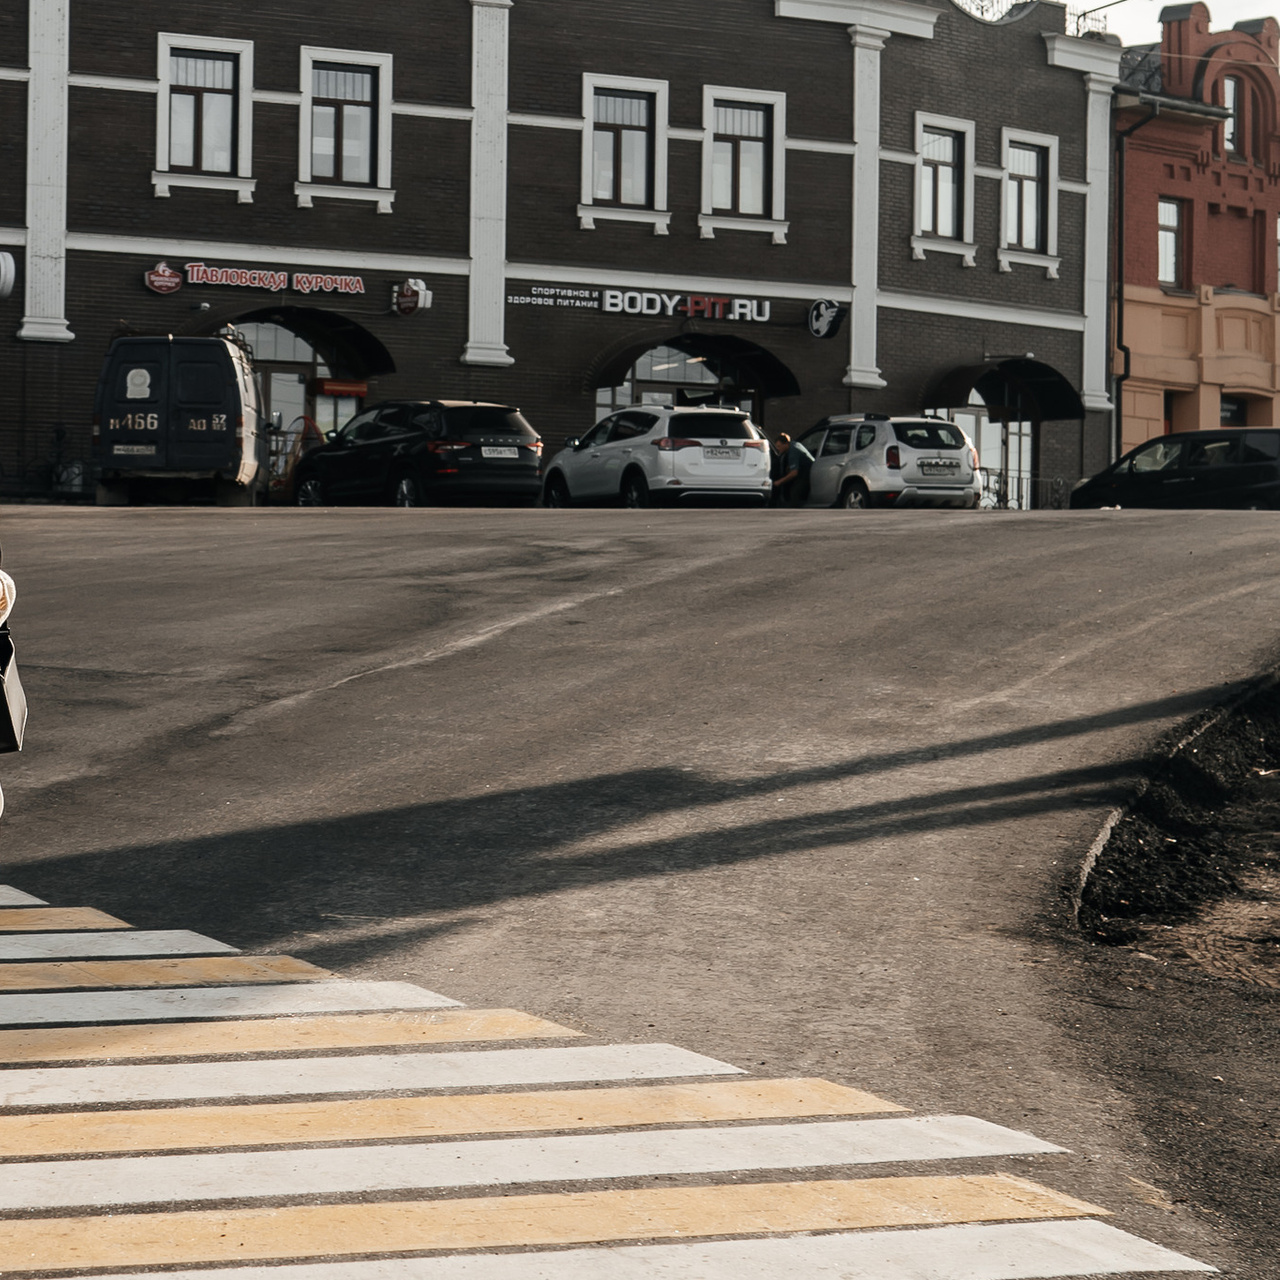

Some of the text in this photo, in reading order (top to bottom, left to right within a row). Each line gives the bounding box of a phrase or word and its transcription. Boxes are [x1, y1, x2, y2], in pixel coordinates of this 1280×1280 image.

[531, 287, 590, 298] СПОРТИВНОЕ
[507, 295, 599, 308] ЗДОРОВОЕ ПИТАНИЕ
